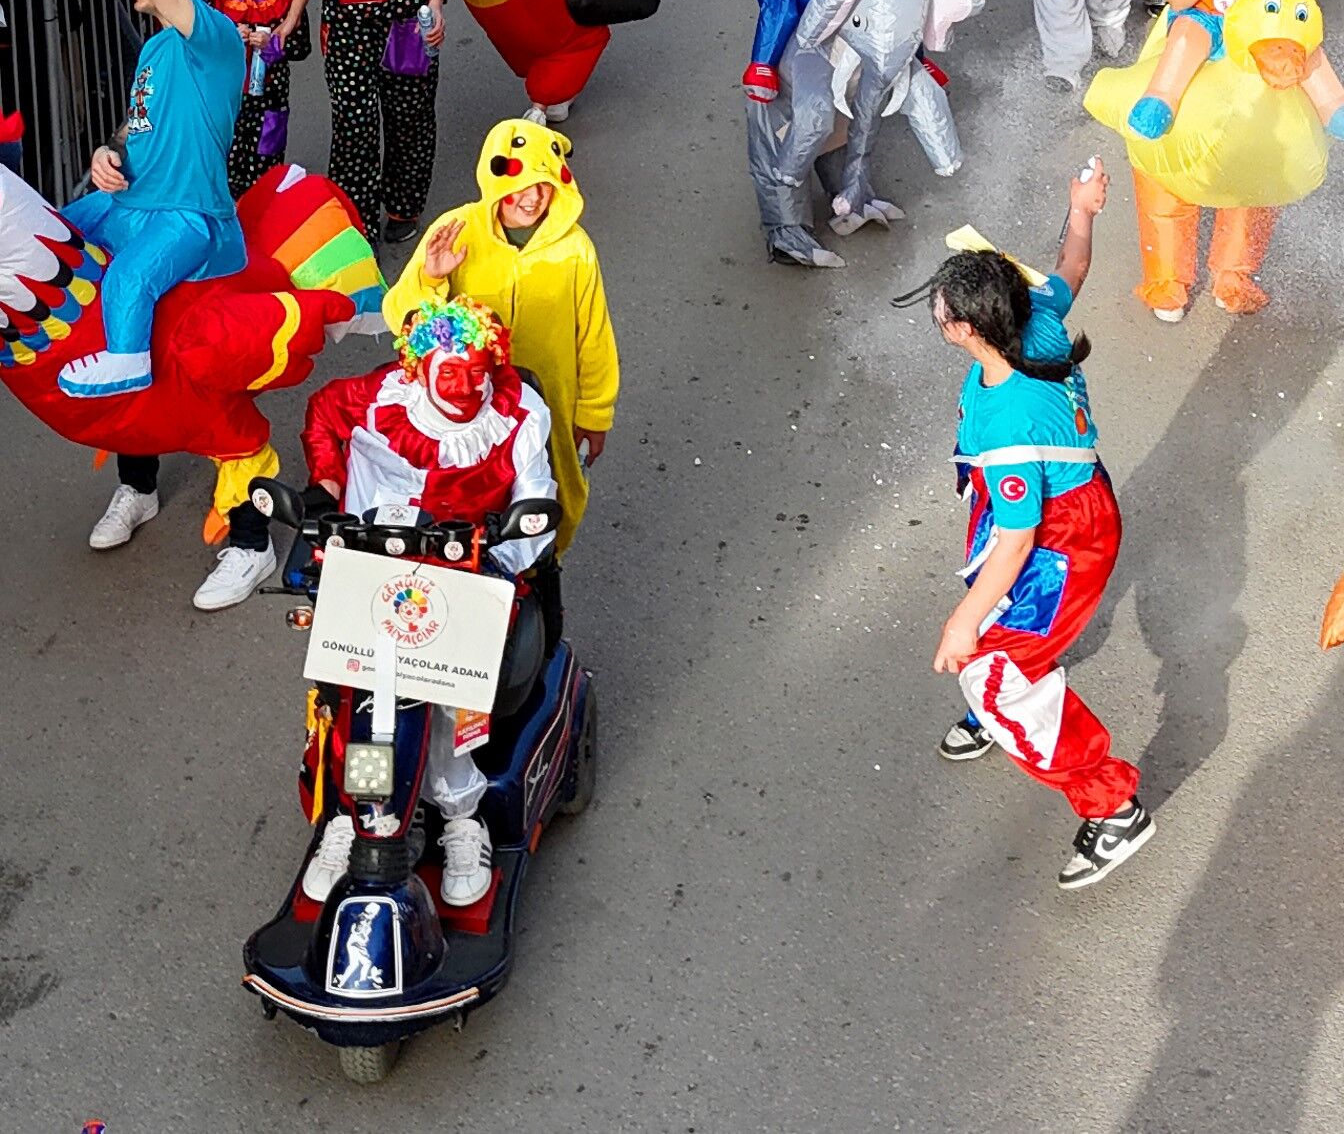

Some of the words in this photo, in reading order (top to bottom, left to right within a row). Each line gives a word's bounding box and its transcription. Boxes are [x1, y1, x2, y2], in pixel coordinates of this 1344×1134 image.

[321, 640, 376, 659] GÖNÜLLÜ
[397, 655, 450, 675] YAÇOLAR
[451, 666, 490, 680] ADANA
